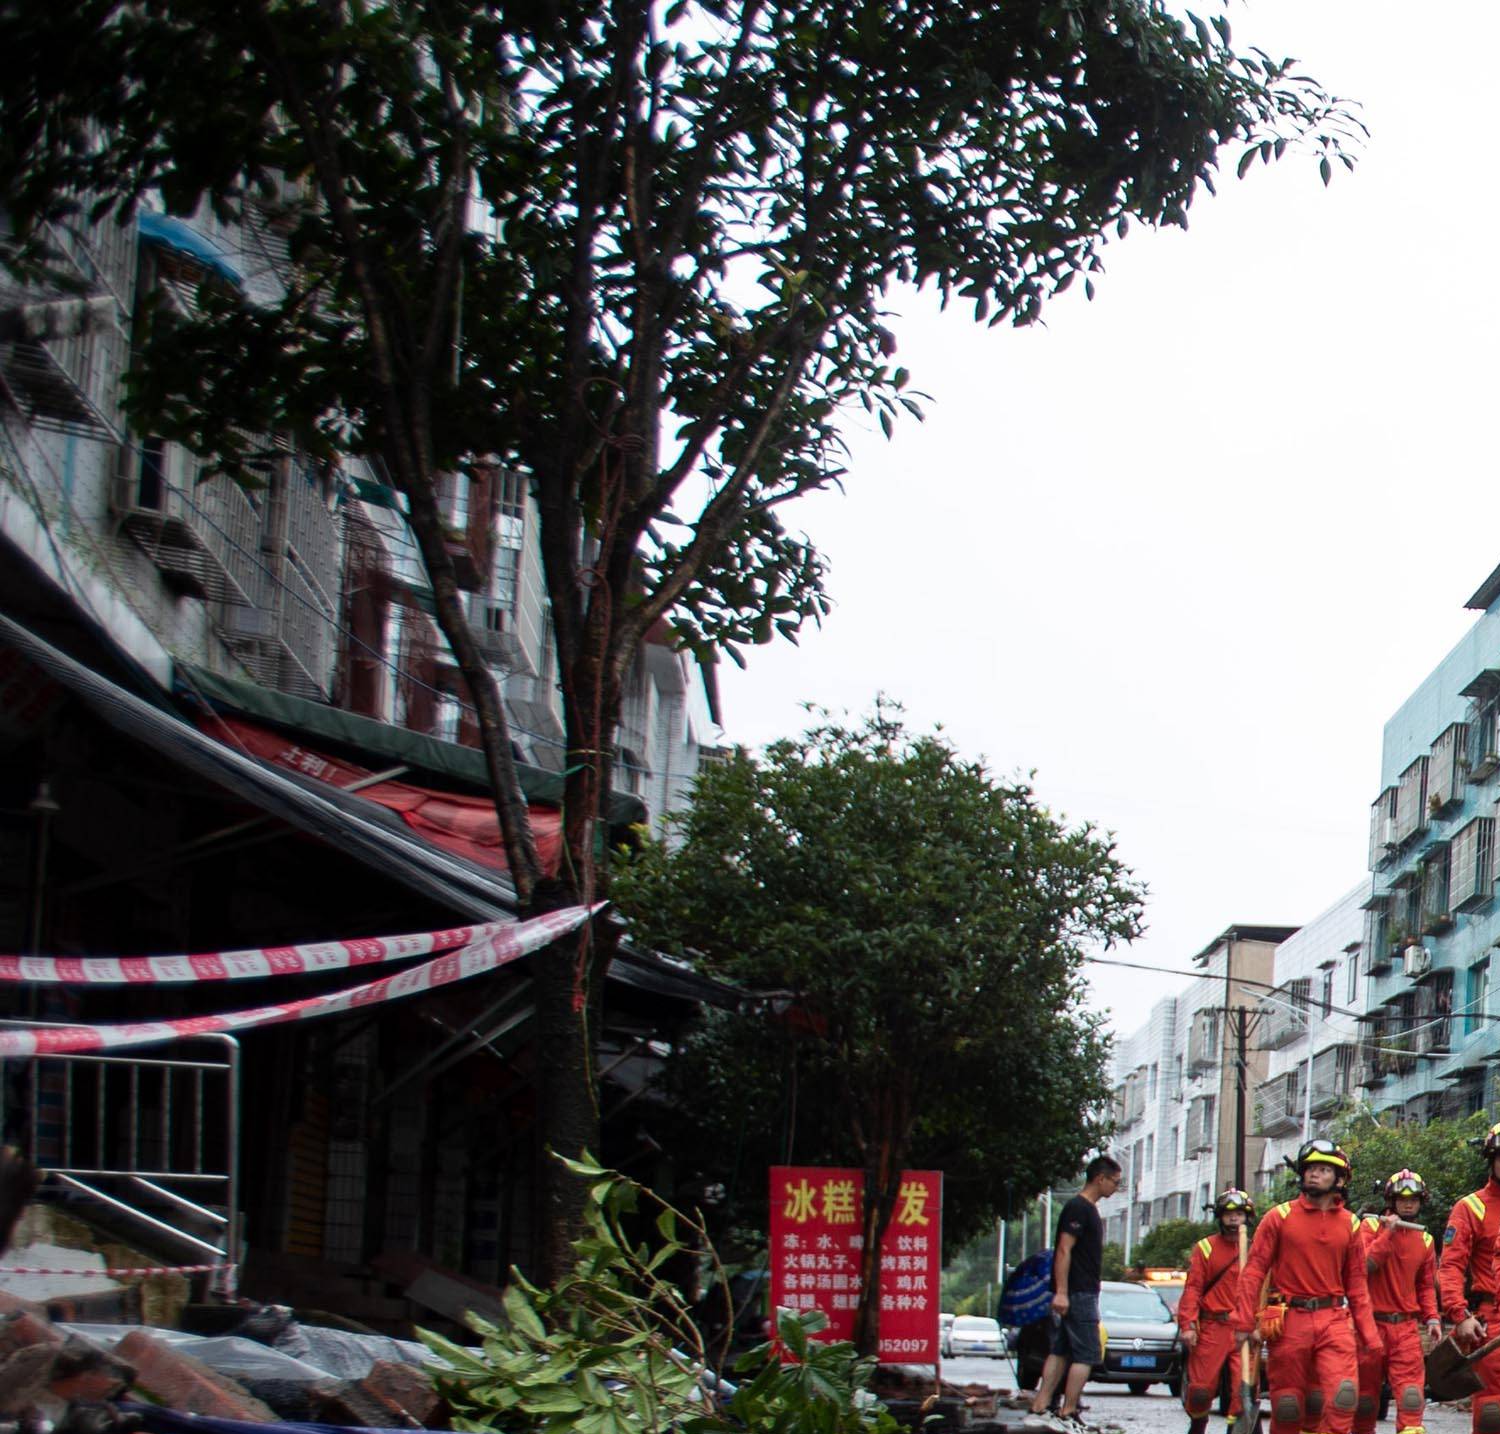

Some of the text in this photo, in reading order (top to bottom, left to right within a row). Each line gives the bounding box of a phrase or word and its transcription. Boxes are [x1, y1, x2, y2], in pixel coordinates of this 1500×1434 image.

[784, 1179, 929, 1226] 冰糕发
[784, 1254, 928, 1270] 火锅丸子、烤系列
[784, 1274, 928, 1290] 各种汤圆水、鸡爪
